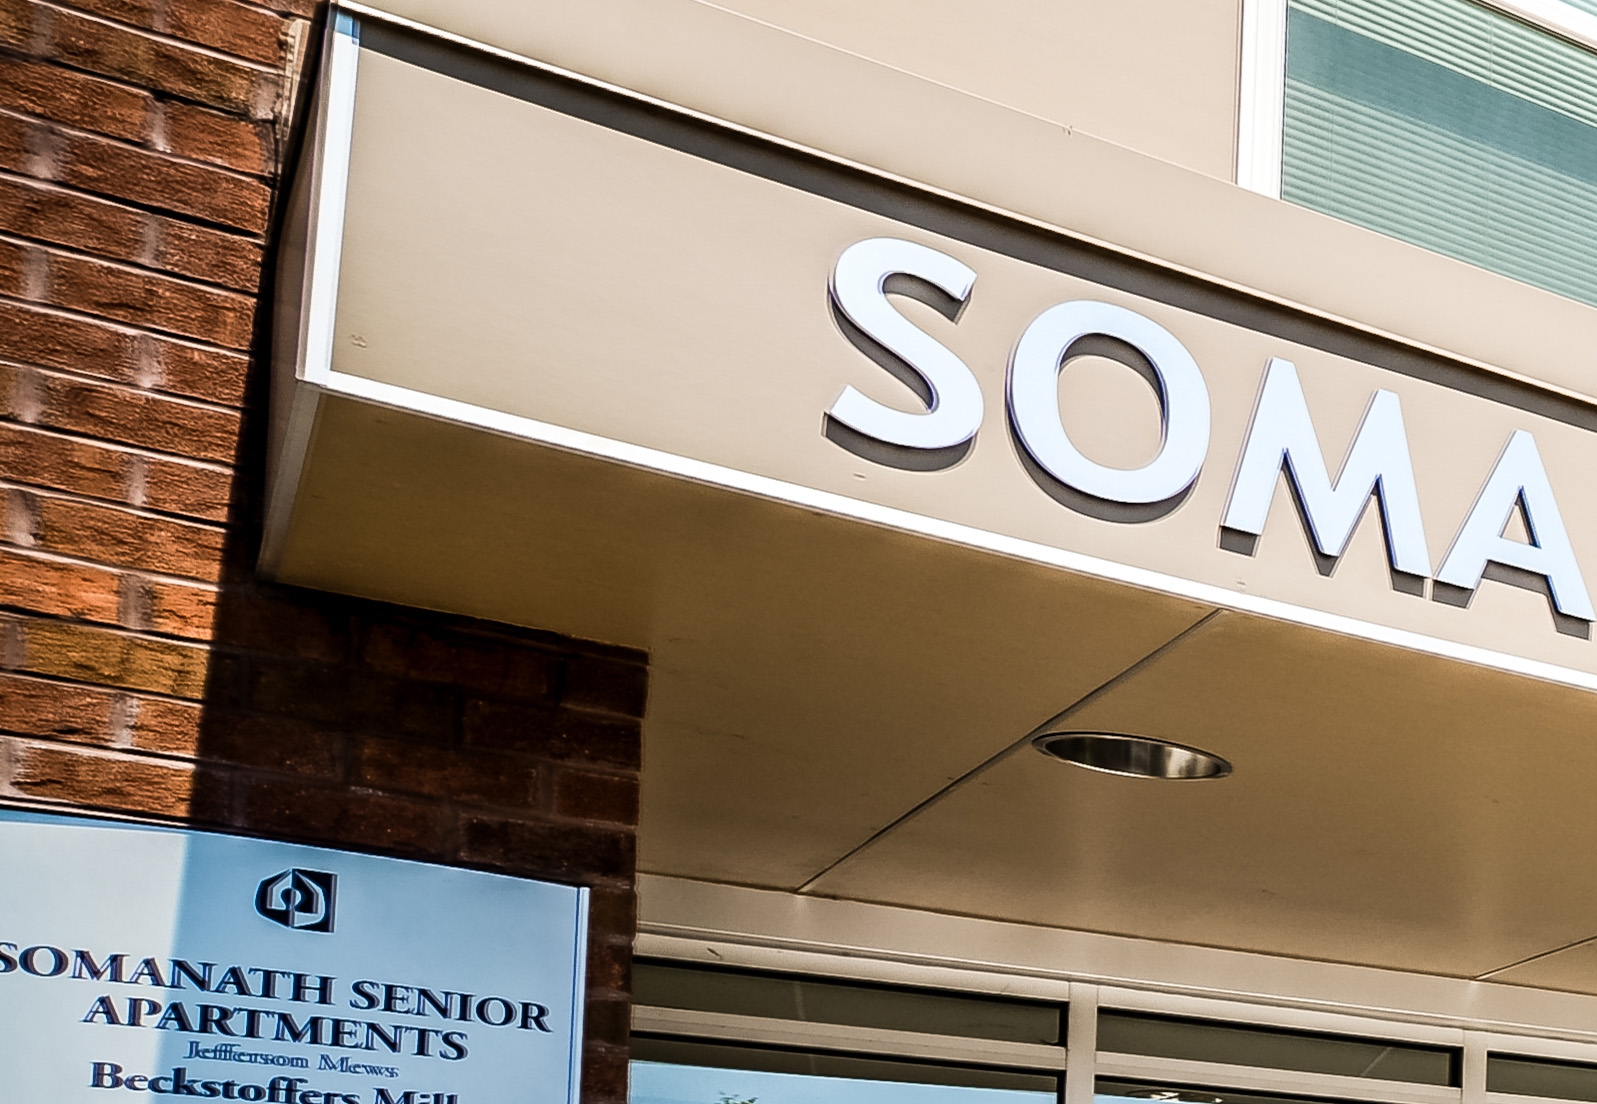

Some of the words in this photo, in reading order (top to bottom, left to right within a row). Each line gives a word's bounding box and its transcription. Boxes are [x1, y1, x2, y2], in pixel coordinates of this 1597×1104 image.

[0, 942, 336, 1005] SOMANATH
[349, 979, 553, 1032] SENIOR
[82, 995, 468, 1061] APARTMENTS
[183, 1041, 309, 1070] Jefferson
[318, 1054, 399, 1078] Mews
